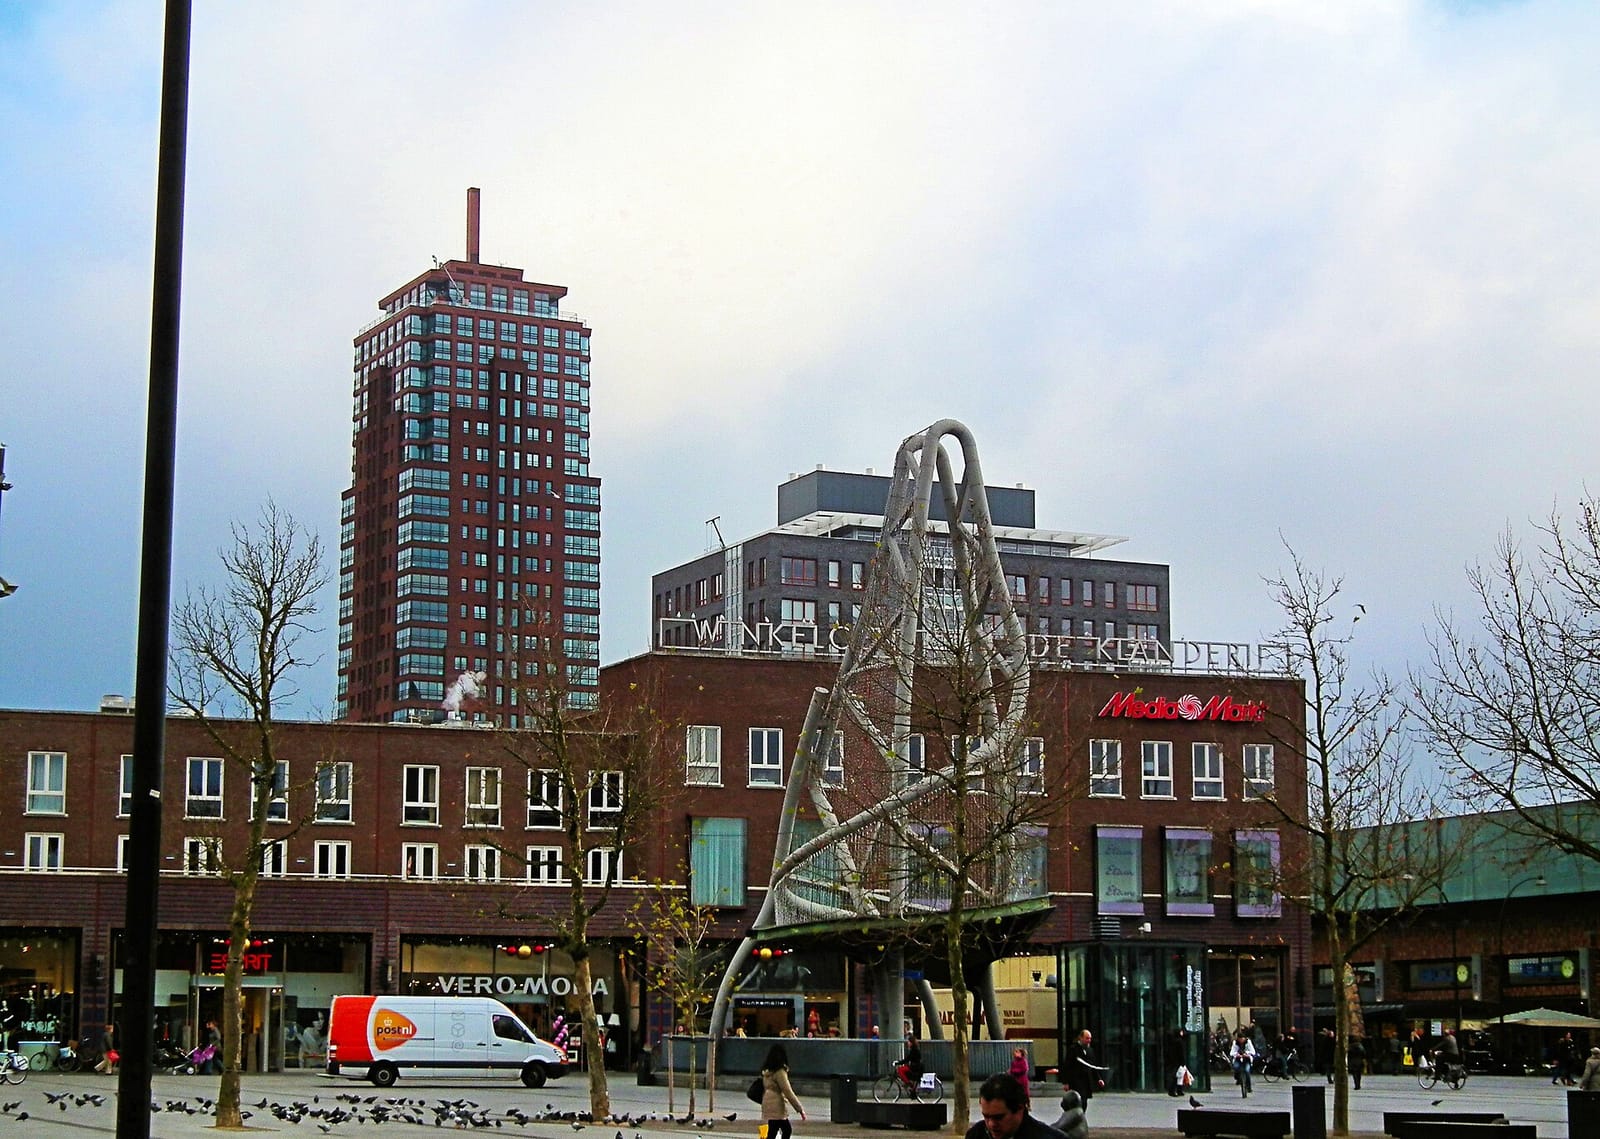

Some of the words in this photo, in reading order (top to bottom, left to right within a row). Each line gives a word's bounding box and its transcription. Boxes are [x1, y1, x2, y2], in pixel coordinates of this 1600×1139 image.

[1030, 634, 1070, 658] DE
[1098, 691, 1178, 719] Media
[210, 953, 273, 970] ESRIT
[438, 976, 516, 994] VERO
[522, 977, 609, 996] MOA
[376, 1024, 413, 1036] postnl
